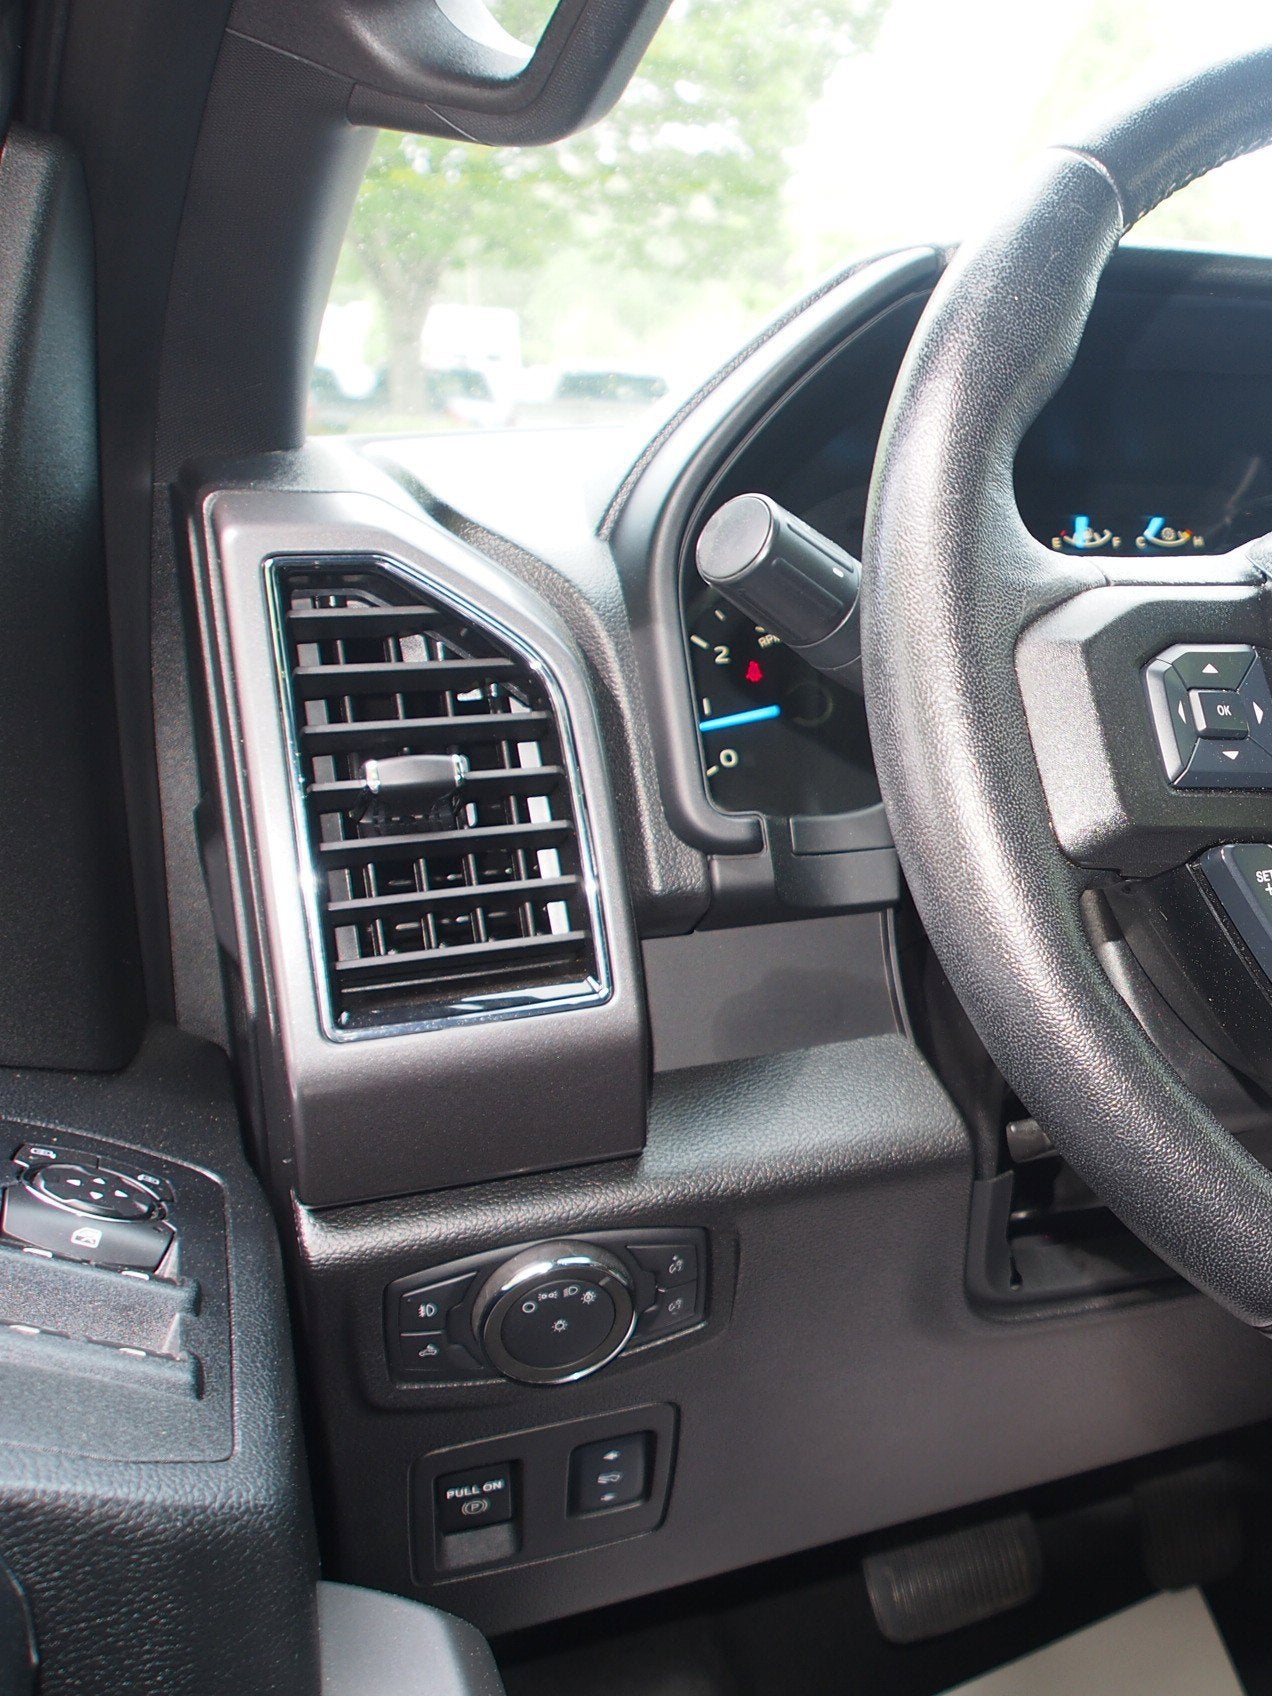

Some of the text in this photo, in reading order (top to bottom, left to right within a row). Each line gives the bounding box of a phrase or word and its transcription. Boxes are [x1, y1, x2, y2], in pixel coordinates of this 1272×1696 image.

[1052, 537, 1062, 549] E
[1112, 536, 1121, 549] F
[1136, 536, 1147, 549] C
[713, 645, 731, 665] 2
[1216, 704, 1232, 716] OK
[719, 748, 739, 768] 0
[446, 1479, 504, 1500] PULL ON
